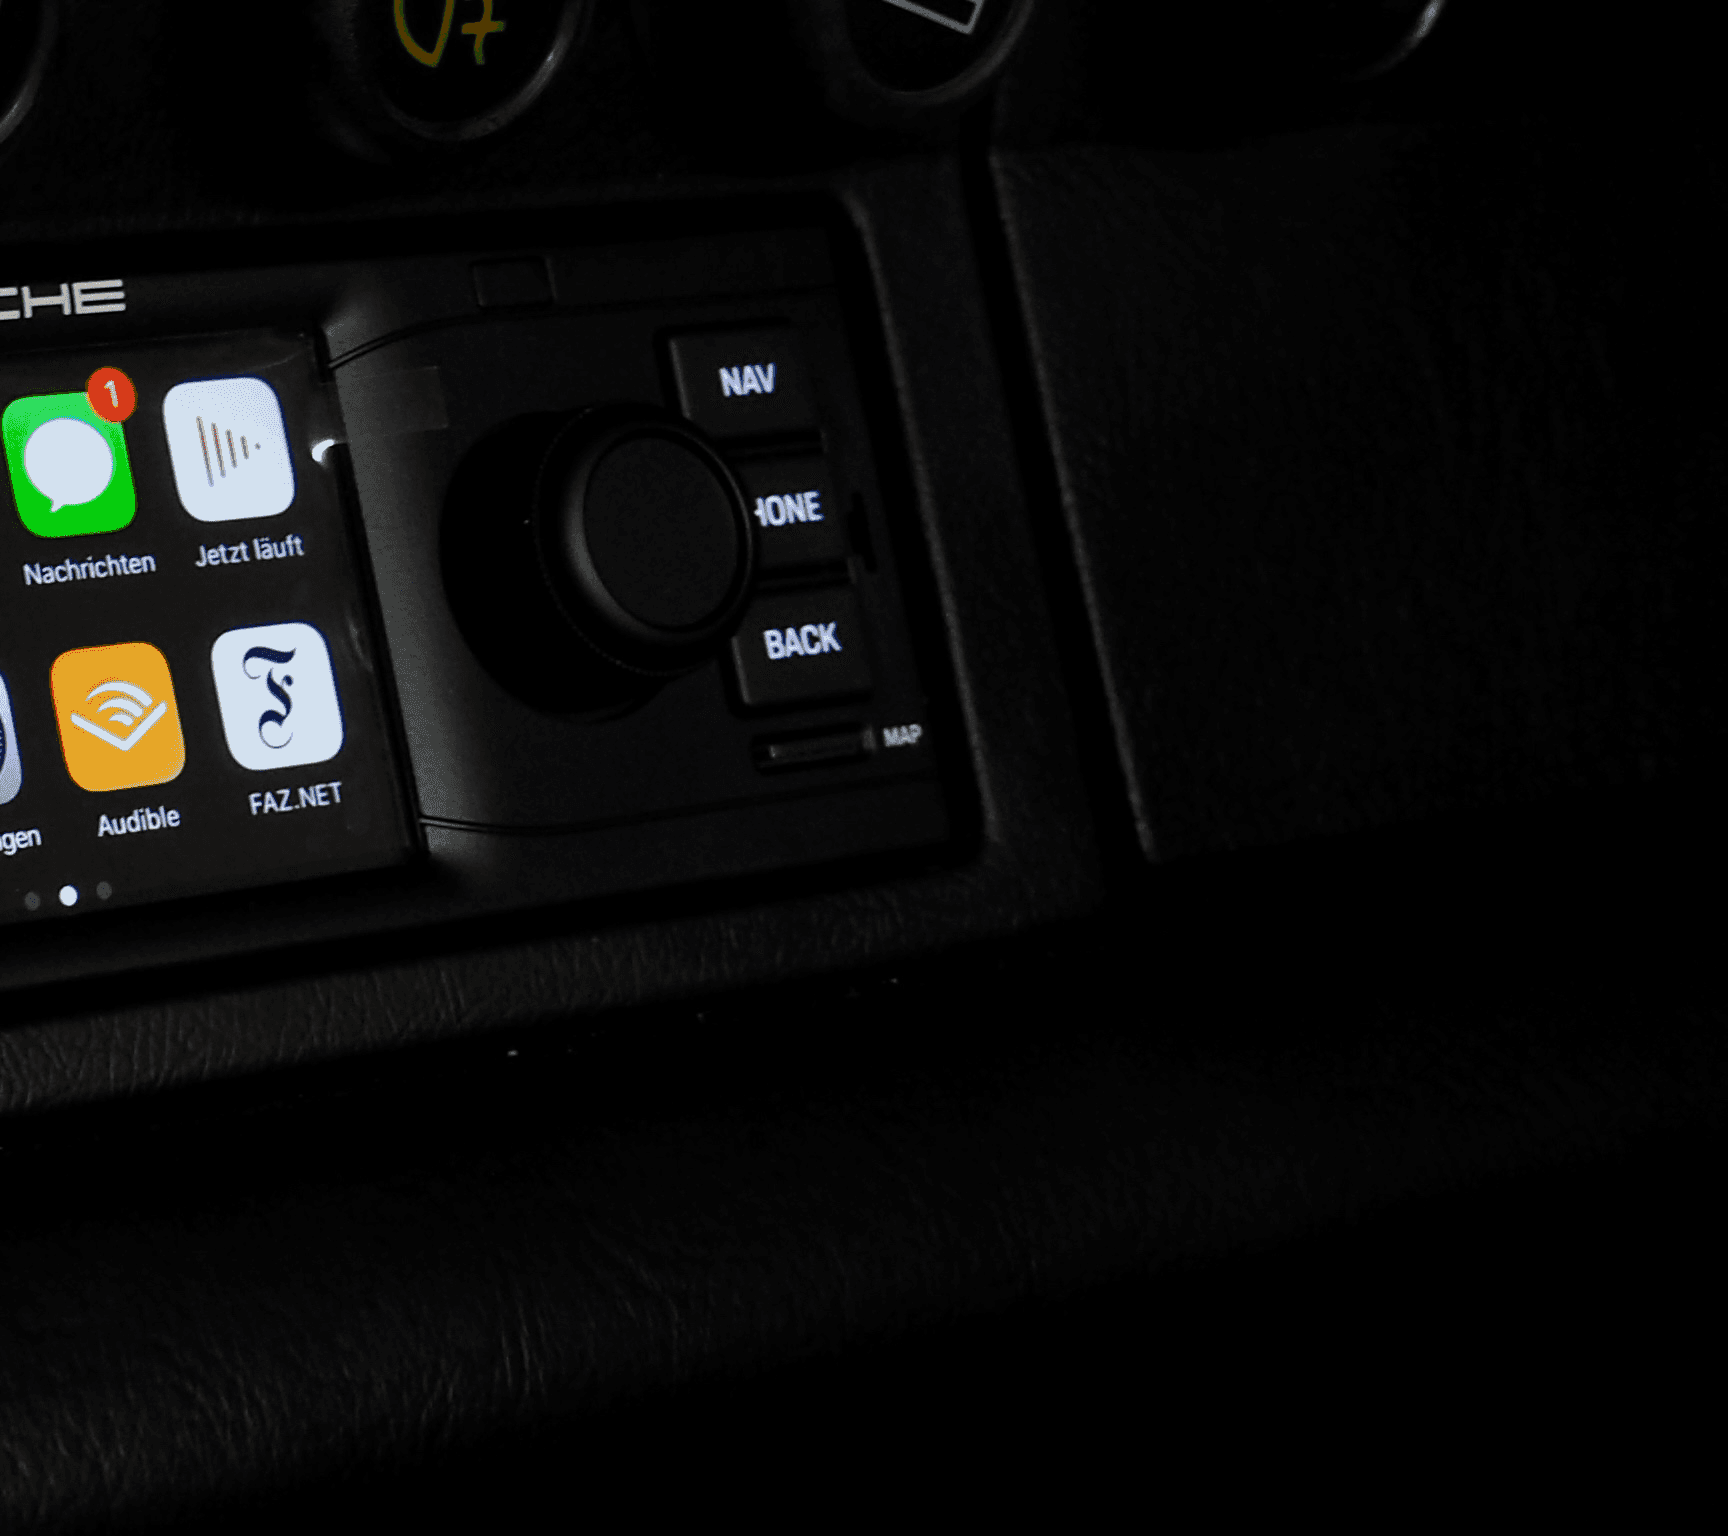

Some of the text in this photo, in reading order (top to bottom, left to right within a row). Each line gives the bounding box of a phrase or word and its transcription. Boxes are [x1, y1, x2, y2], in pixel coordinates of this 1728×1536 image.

[103, 380, 118, 408] 1
[718, 362, 777, 398] NAV
[23, 551, 157, 586] Nachrichten
[195, 534, 304, 569] Jetzt läuft
[762, 622, 843, 660] BACK
[882, 722, 923, 748] MAP
[248, 782, 343, 815] FAZ.NET
[97, 807, 181, 836] Audible
